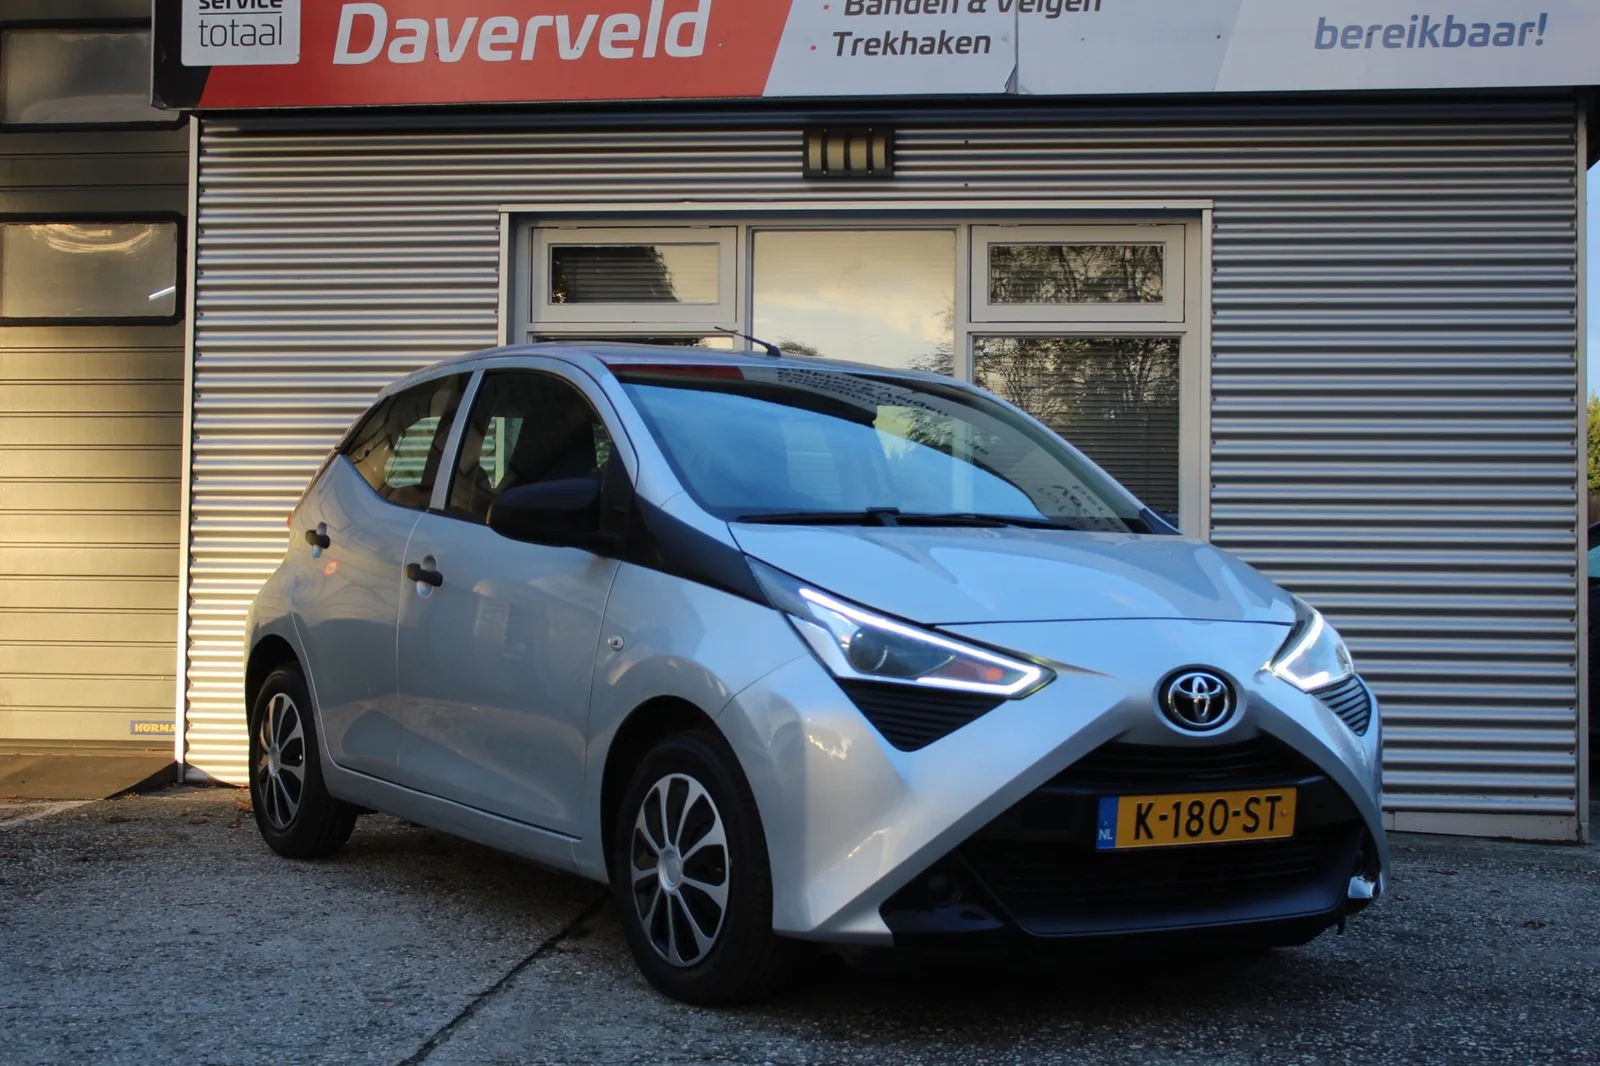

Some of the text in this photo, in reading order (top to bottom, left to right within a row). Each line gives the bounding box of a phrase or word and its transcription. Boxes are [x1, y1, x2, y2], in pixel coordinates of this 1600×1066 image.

[198, 15, 283, 47] totaal
[332, 0, 711, 65] Daverveld
[832, 29, 992, 57] Trekhaken
[1314, 12, 1548, 50] bereikbaar!
[1098, 828, 1114, 841] NL
[1134, 795, 1283, 840] K-180-ST
